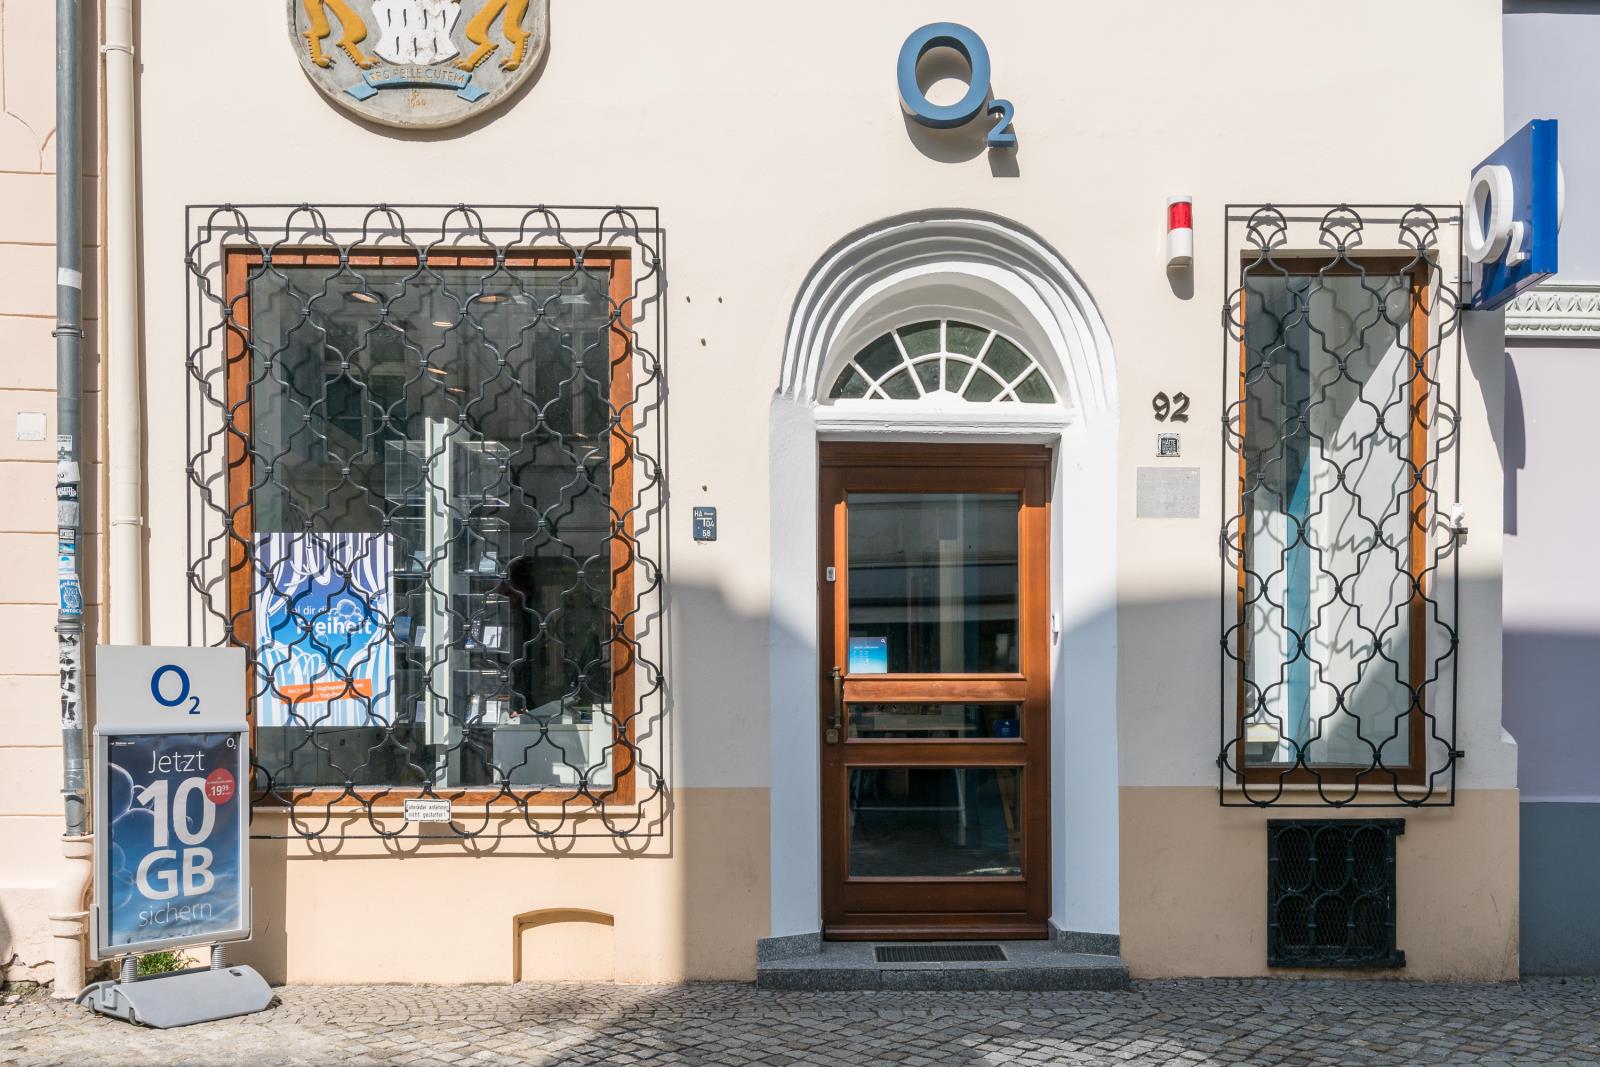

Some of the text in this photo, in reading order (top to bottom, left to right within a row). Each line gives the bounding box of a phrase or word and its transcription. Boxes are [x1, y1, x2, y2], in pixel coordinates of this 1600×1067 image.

[896, 22, 1016, 148] O2
[1152, 391, 1191, 424] 92
[296, 616, 372, 635] Feiheit
[303, 606, 316, 615] dir
[150, 664, 201, 715] O2
[148, 750, 205, 774] Jetzt
[136, 776, 216, 848] 10
[136, 847, 215, 901] GB
[138, 901, 212, 927] sichern
